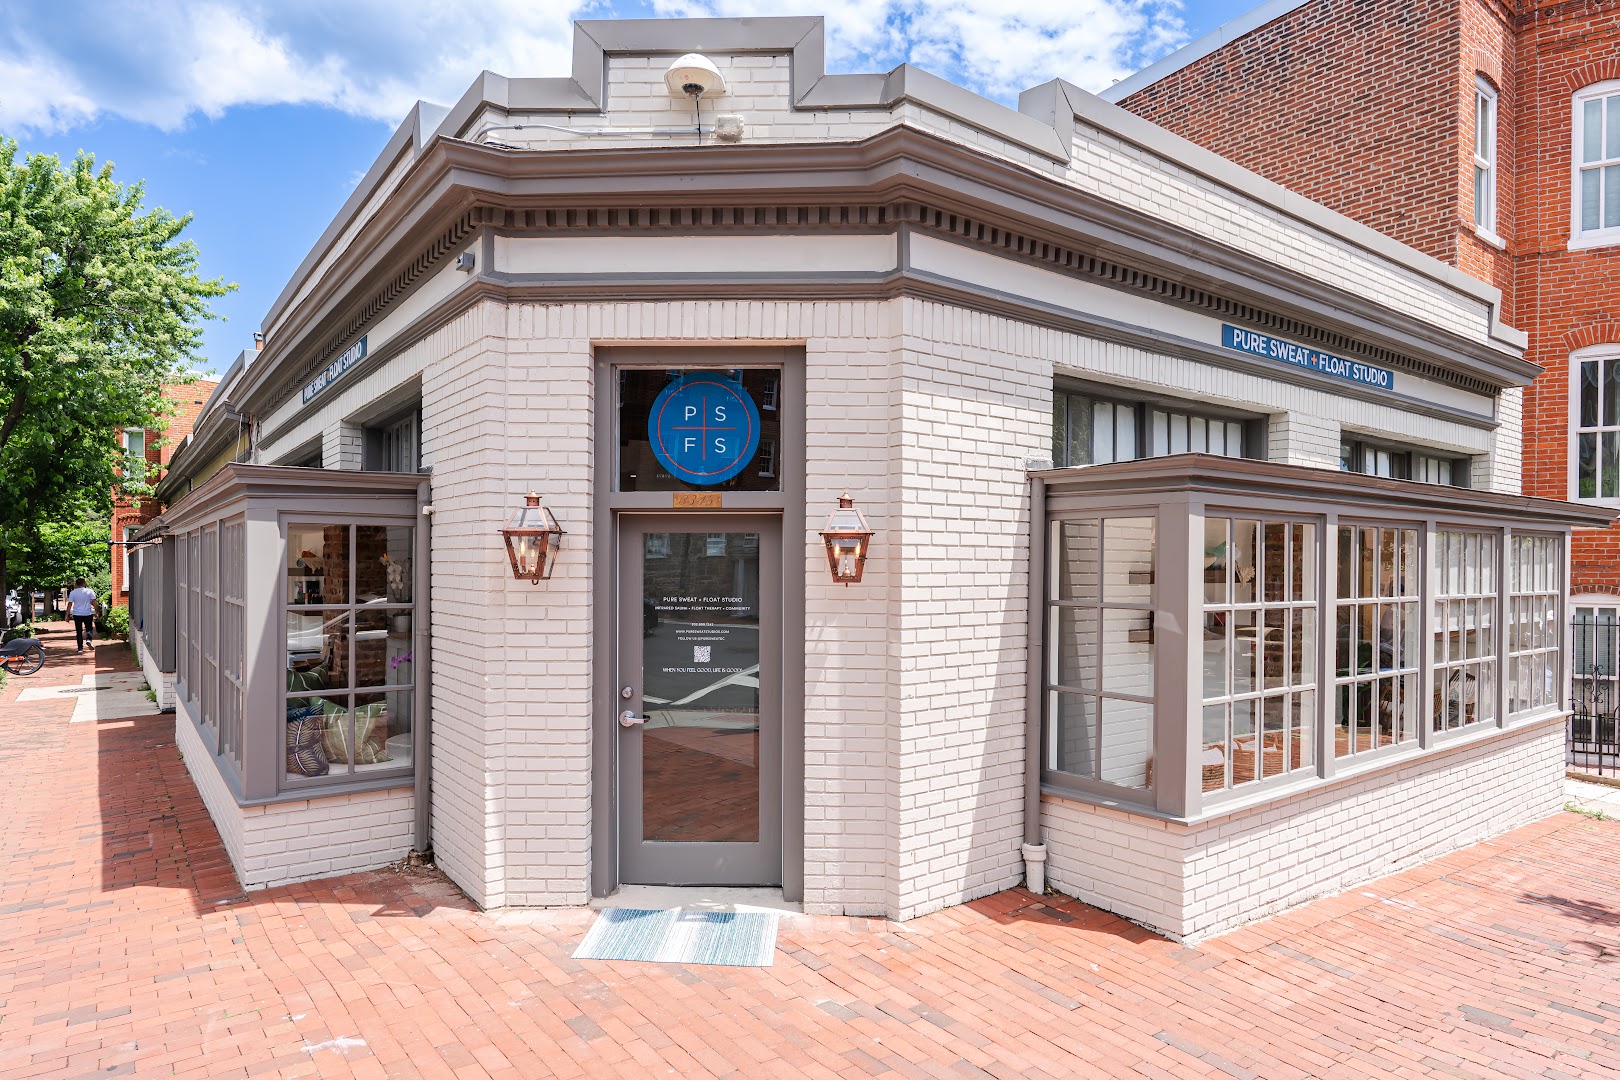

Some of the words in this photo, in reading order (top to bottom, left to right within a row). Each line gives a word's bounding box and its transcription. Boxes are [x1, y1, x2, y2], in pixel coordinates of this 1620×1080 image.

[303, 383, 314, 402] PURE
[329, 357, 343, 381] FLOAT
[343, 341, 362, 370] STUDIO
[1233, 329, 1267, 354] PURE
[1269, 340, 1310, 366] SWEAT
[1318, 354, 1351, 377] FLOAT
[1352, 363, 1388, 386] STUDIO
[685, 406, 697, 421] P
[714, 405, 727, 422] S
[684, 437, 696, 453] F
[714, 437, 727, 453] S
